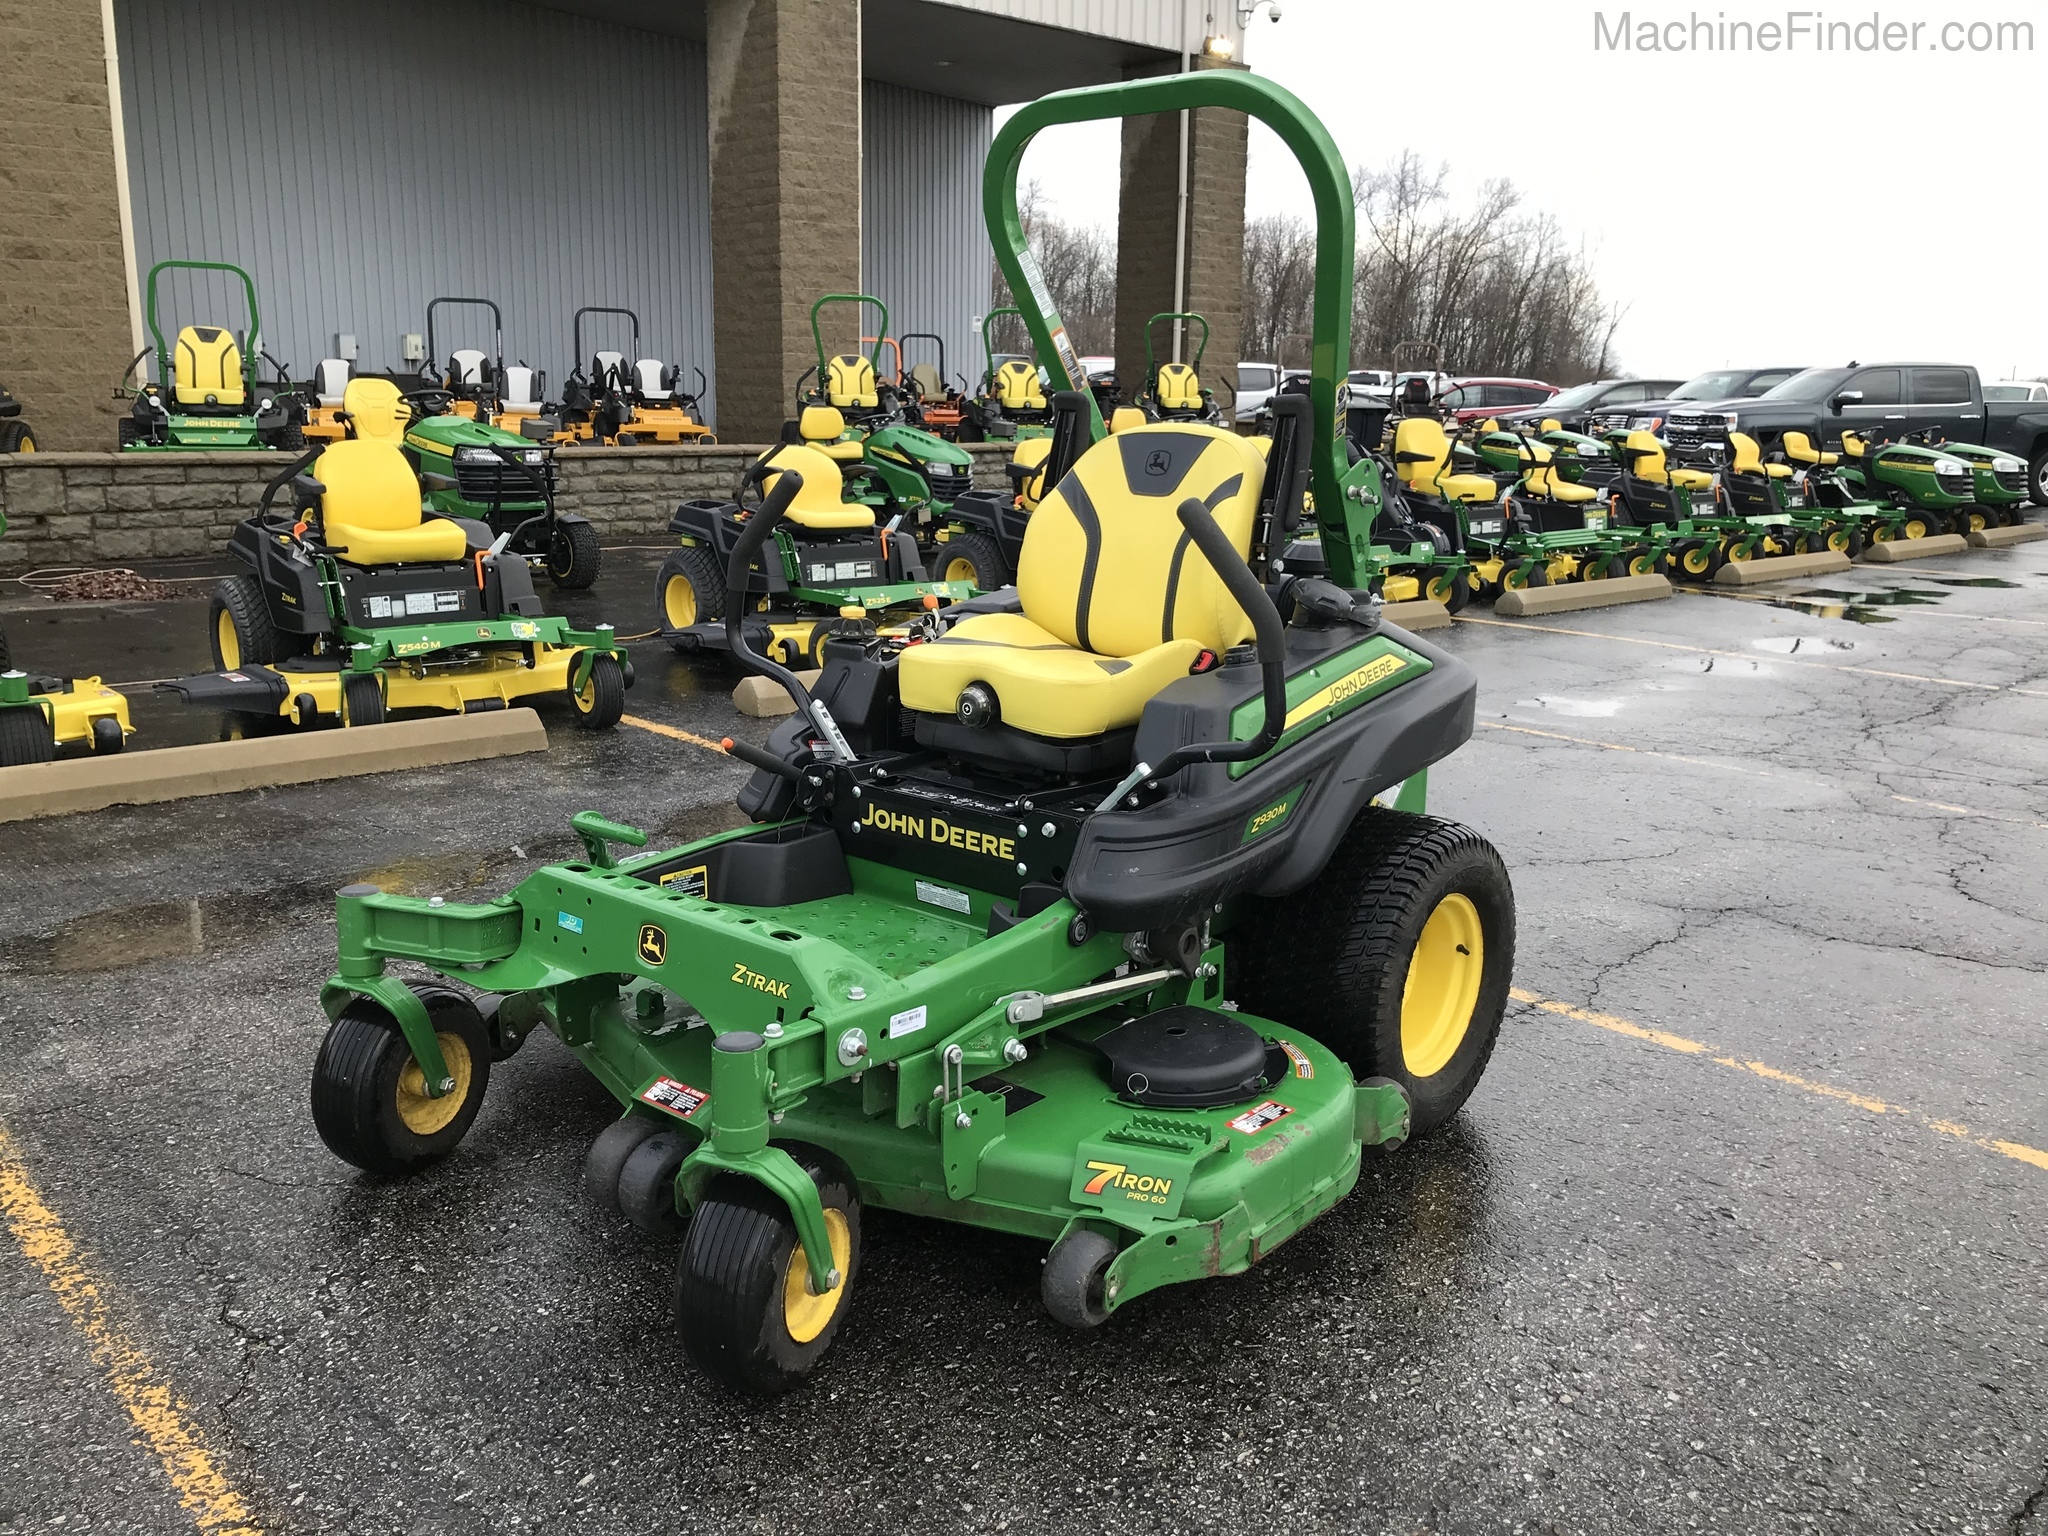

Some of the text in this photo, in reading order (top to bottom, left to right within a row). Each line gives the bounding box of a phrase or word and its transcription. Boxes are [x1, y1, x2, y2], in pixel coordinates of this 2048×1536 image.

[183, 420, 241, 428] JOHN DEERE
[398, 641, 441, 654] Z540 M
[1329, 659, 1394, 704] JOHN DEERE
[861, 802, 1015, 861] JOHN DEERE
[1250, 802, 1287, 834] Z930M
[731, 963, 791, 1000] ZTRAK
[1113, 1172, 1173, 1195] IRON
[1126, 1191, 1167, 1205] PRO 60
